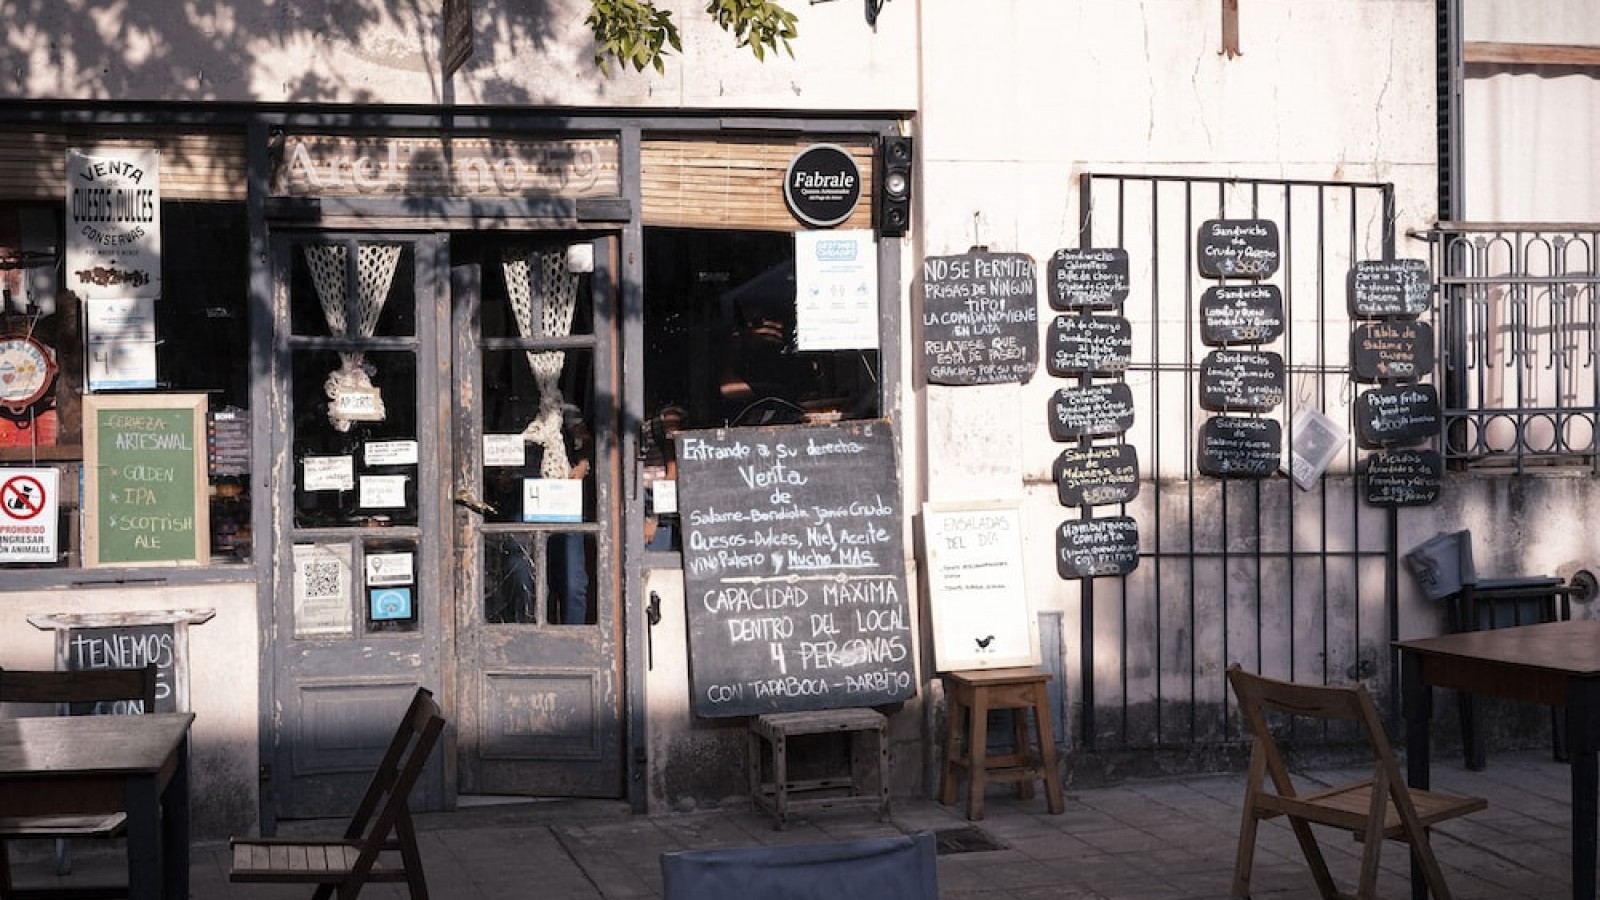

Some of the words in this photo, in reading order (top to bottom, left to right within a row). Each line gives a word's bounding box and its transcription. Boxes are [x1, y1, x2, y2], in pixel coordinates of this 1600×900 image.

[80, 161, 143, 184] VENTA
[794, 171, 854, 188] Fabrale
[74, 189, 112, 223] QUESOS
[117, 189, 153, 222] DULCES
[82, 226, 145, 246] CONSERVAS
[924, 260, 948, 282] NO
[950, 261, 970, 280] SE
[974, 324, 1000, 335] LATA
[115, 432, 192, 450] ARTESANAL
[683, 439, 750, 460] Entrando
[757, 444, 769, 457] a
[807, 438, 864, 456] derecha
[123, 466, 174, 482] GOLDEN
[739, 461, 808, 489] Venta
[124, 488, 156, 506] IPA
[770, 487, 792, 504] de
[850, 495, 892, 516] Crudo
[943, 516, 1010, 532] ENSALADAS
[11, 545, 50, 554] ANIMALES
[135, 535, 161, 549] ALE
[946, 537, 968, 550] DEL
[788, 550, 832, 566] Mucho
[704, 585, 808, 613] CAPACIDAD
[728, 616, 794, 642] DENTRO
[810, 613, 840, 637] DEL
[856, 605, 909, 633] LOCAL
[770, 643, 787, 674] 4
[707, 684, 742, 702] CON
